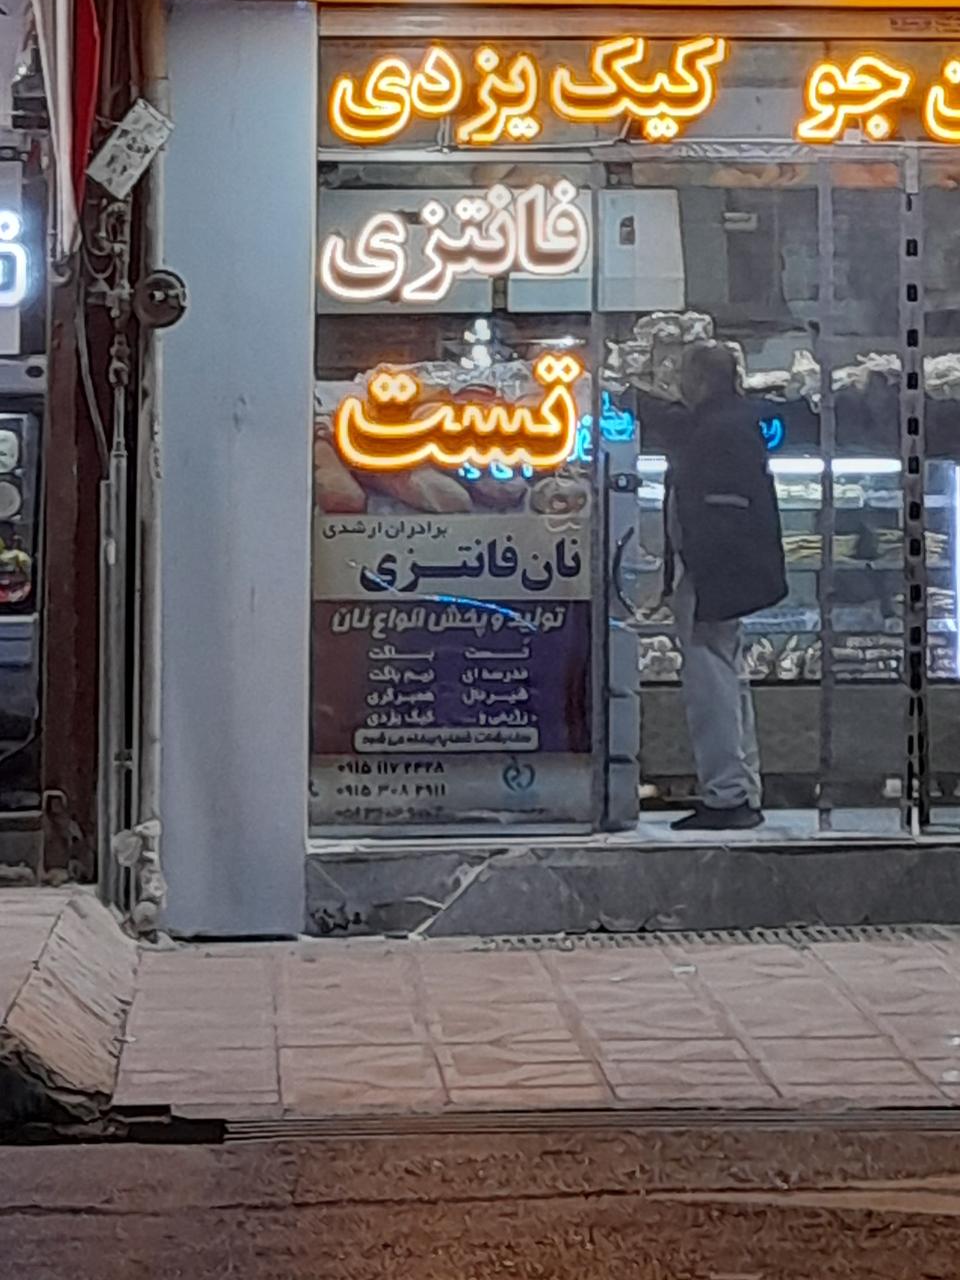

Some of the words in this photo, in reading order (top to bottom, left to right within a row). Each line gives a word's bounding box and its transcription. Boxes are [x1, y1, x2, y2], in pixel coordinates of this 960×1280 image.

[333, 47, 540, 143] یزدی
[553, 37, 728, 139] کیک
[797, 55, 910, 138] جو
[322, 179, 588, 300] فانتزی
[338, 355, 580, 465] تست
[322, 521, 382, 539] ارشدی
[386, 521, 447, 539] برادران
[360, 535, 518, 592] فانتزی
[521, 537, 581, 592] نان
[332, 606, 370, 633] نان
[373, 607, 423, 639] انواع
